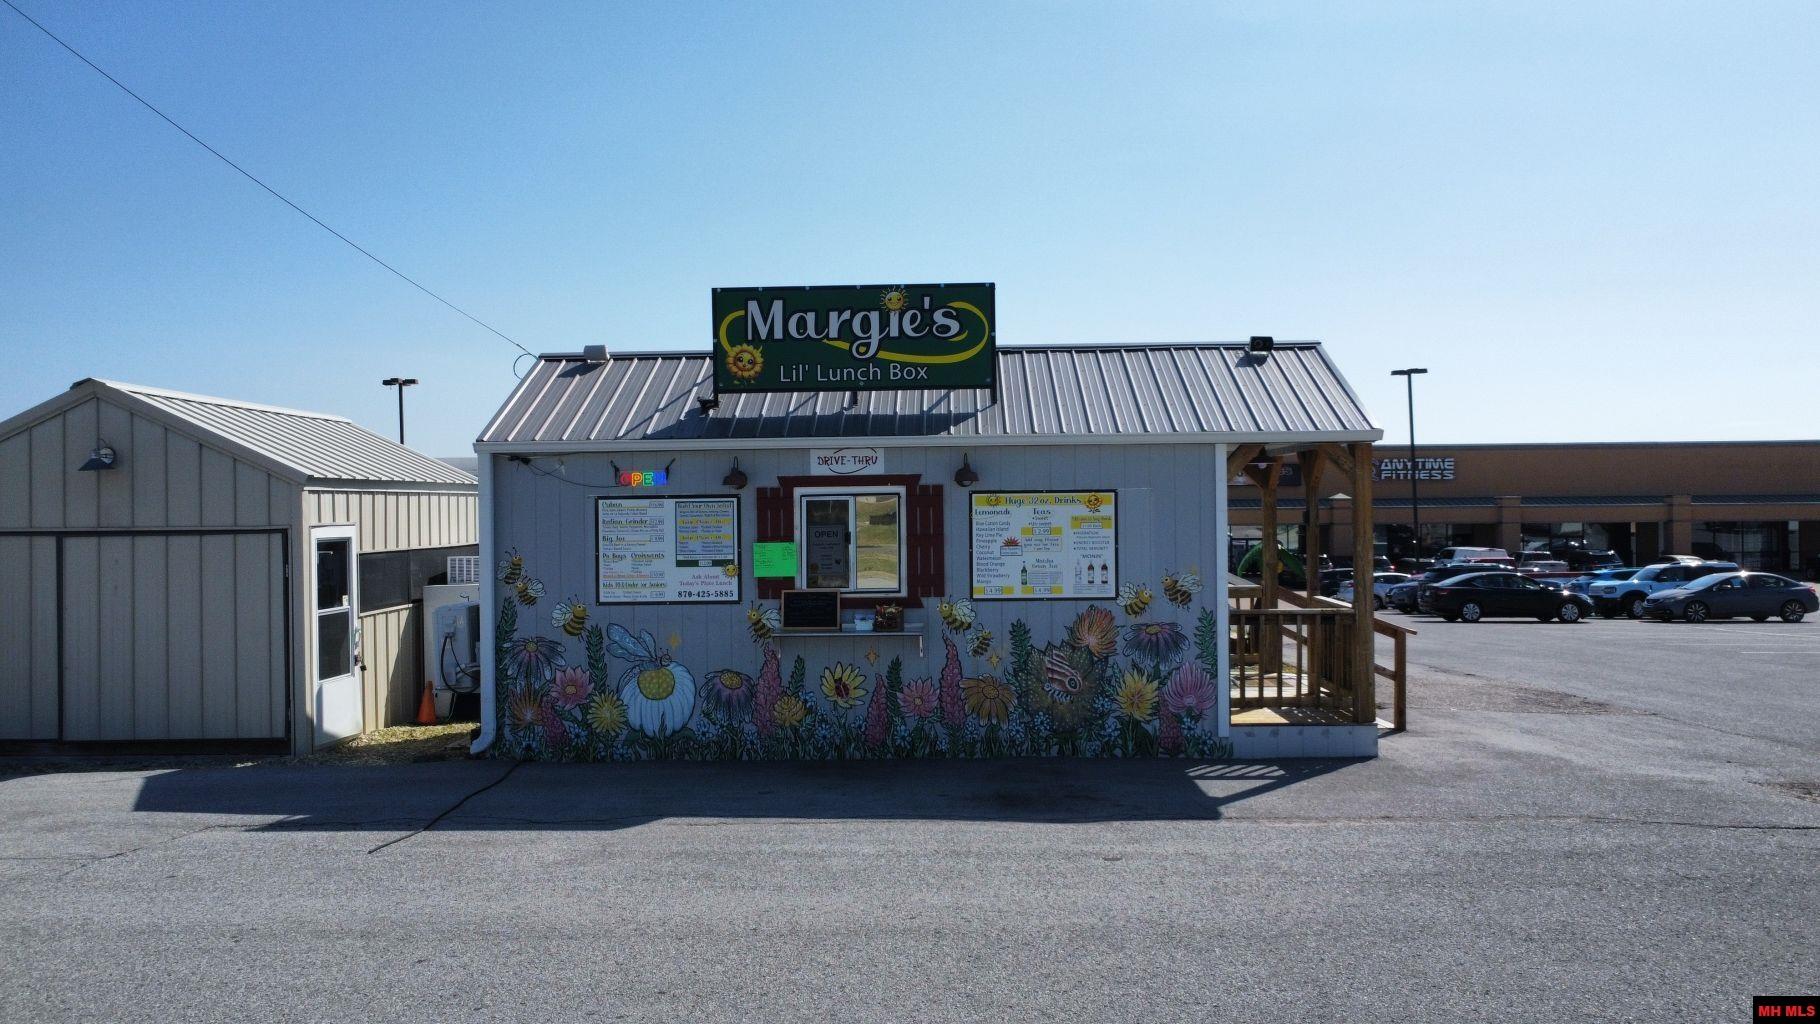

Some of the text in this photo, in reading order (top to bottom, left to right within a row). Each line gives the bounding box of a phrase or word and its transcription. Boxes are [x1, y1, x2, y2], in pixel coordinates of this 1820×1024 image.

[747, 296, 961, 359] Margie's
[780, 362, 928, 382] Lil' Lunch Box
[817, 455, 878, 466] DRIVE-THRU
[1381, 458, 1455, 470] ANYTIME
[619, 471, 667, 486] OPEN
[1381, 471, 1455, 480] FITNESS
[1005, 497, 1024, 508] Huge
[1055, 496, 1082, 504] Drinks
[814, 530, 839, 538] OPEN
